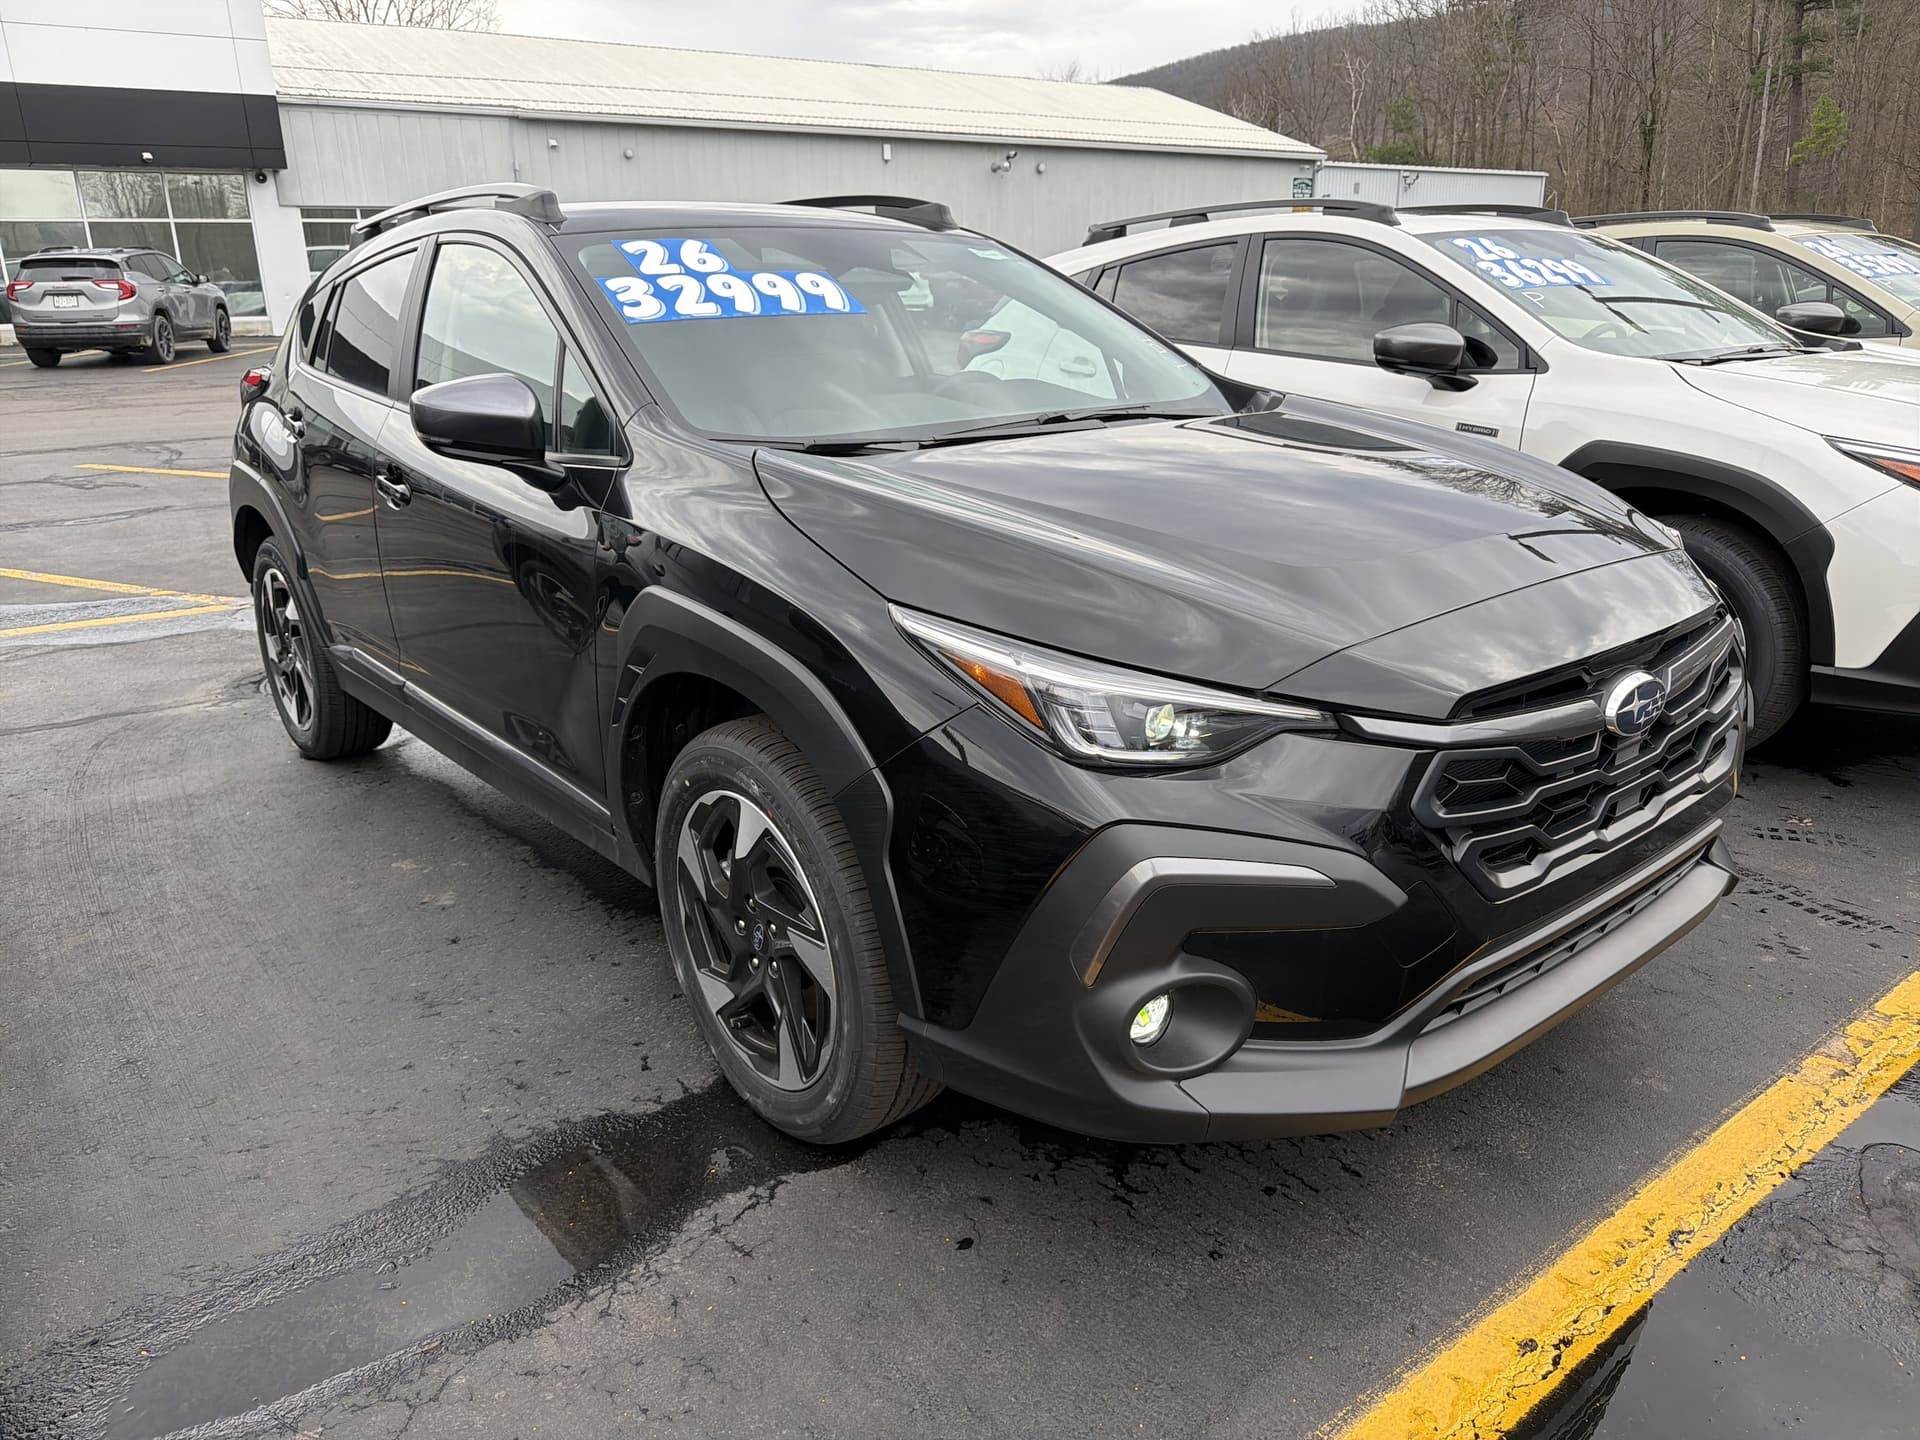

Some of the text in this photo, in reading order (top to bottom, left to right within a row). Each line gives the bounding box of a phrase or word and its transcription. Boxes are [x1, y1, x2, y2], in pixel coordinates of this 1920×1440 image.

[620, 239, 729, 275] 26
[1452, 237, 1519, 261] 26
[1475, 258, 1606, 288] 36299
[605, 272, 850, 320] 32999
[1521, 291, 1545, 309] P
[1460, 424, 1493, 435] HYBRID
